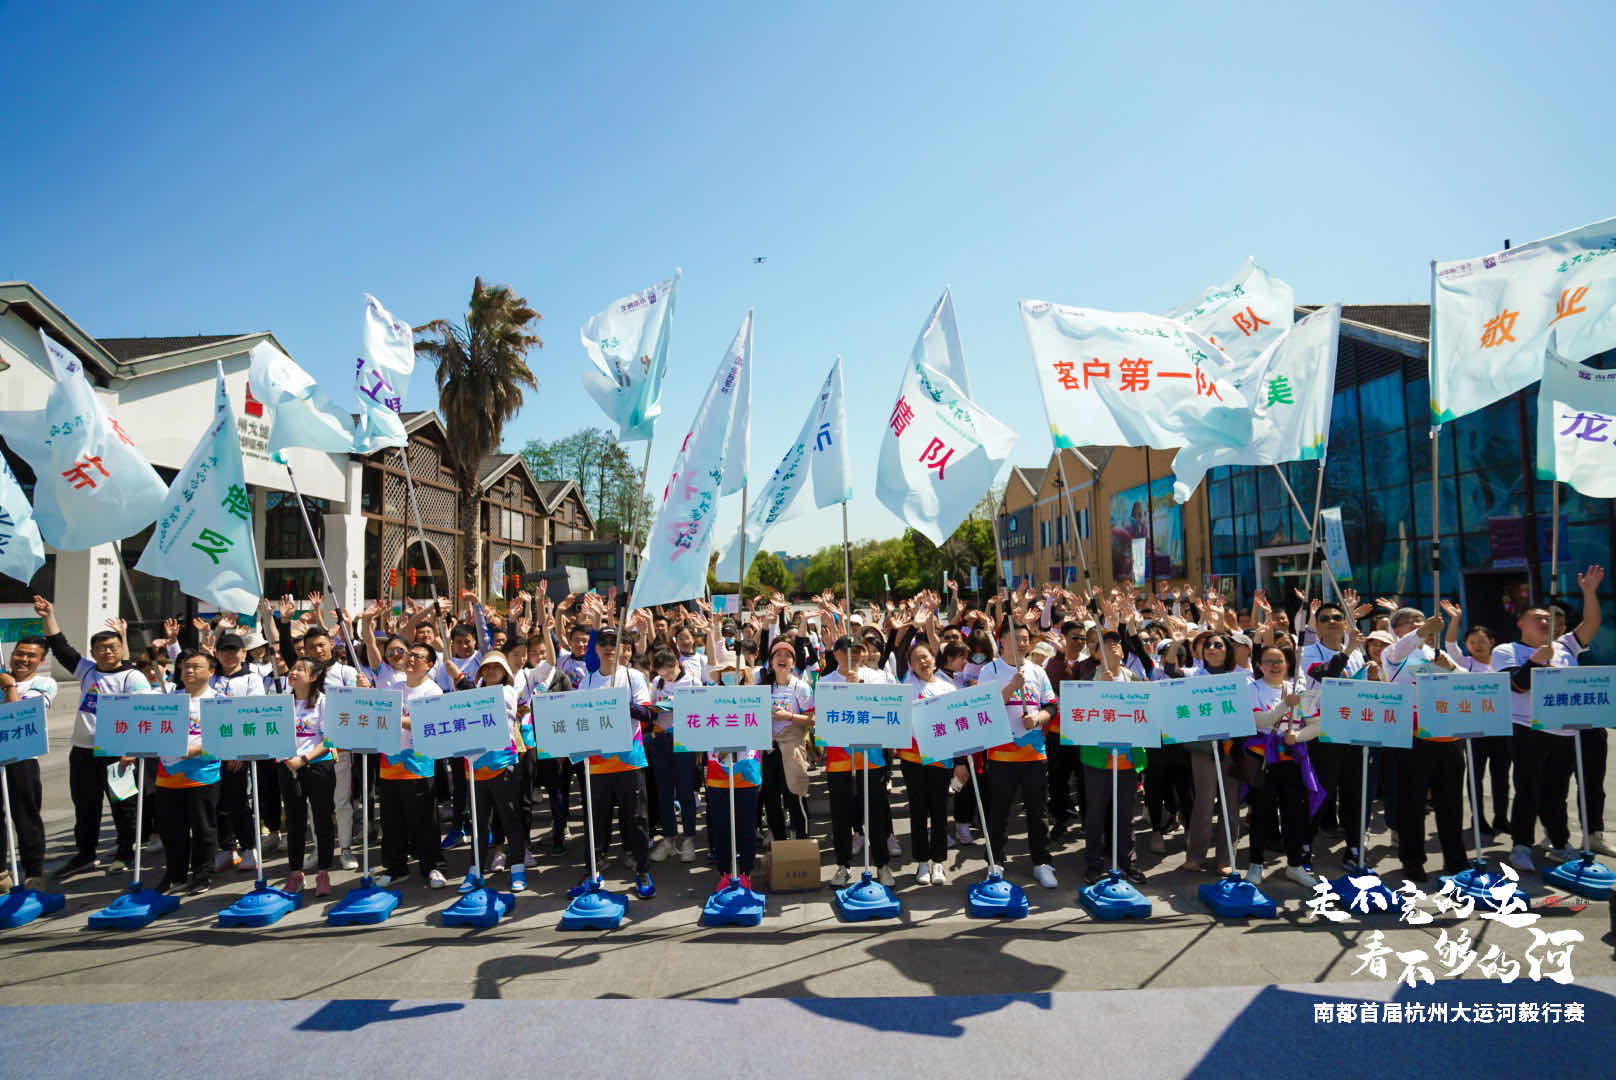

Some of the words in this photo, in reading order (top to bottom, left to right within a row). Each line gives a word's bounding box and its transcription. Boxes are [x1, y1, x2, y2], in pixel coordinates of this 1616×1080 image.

[1053, 357, 1224, 402] 客户第一队
[1435, 699, 1496, 714] 敬业队
[1543, 692, 1610, 707] 龙腾虎跃队
[825, 710, 901, 726] 市场第一队
[1071, 708, 1149, 724] 客户第一队
[1175, 699, 1237, 720] 美好队
[1338, 706, 1398, 724] 专业队
[115, 719, 174, 735] 协作队
[219, 721, 280, 738] 创新队
[338, 712, 389, 730] 芳华队
[423, 713, 497, 738] 员工第一队
[552, 714, 614, 735] 诚信队
[687, 713, 759, 729] 花木兰队
[932, 711, 993, 738] 激情队
